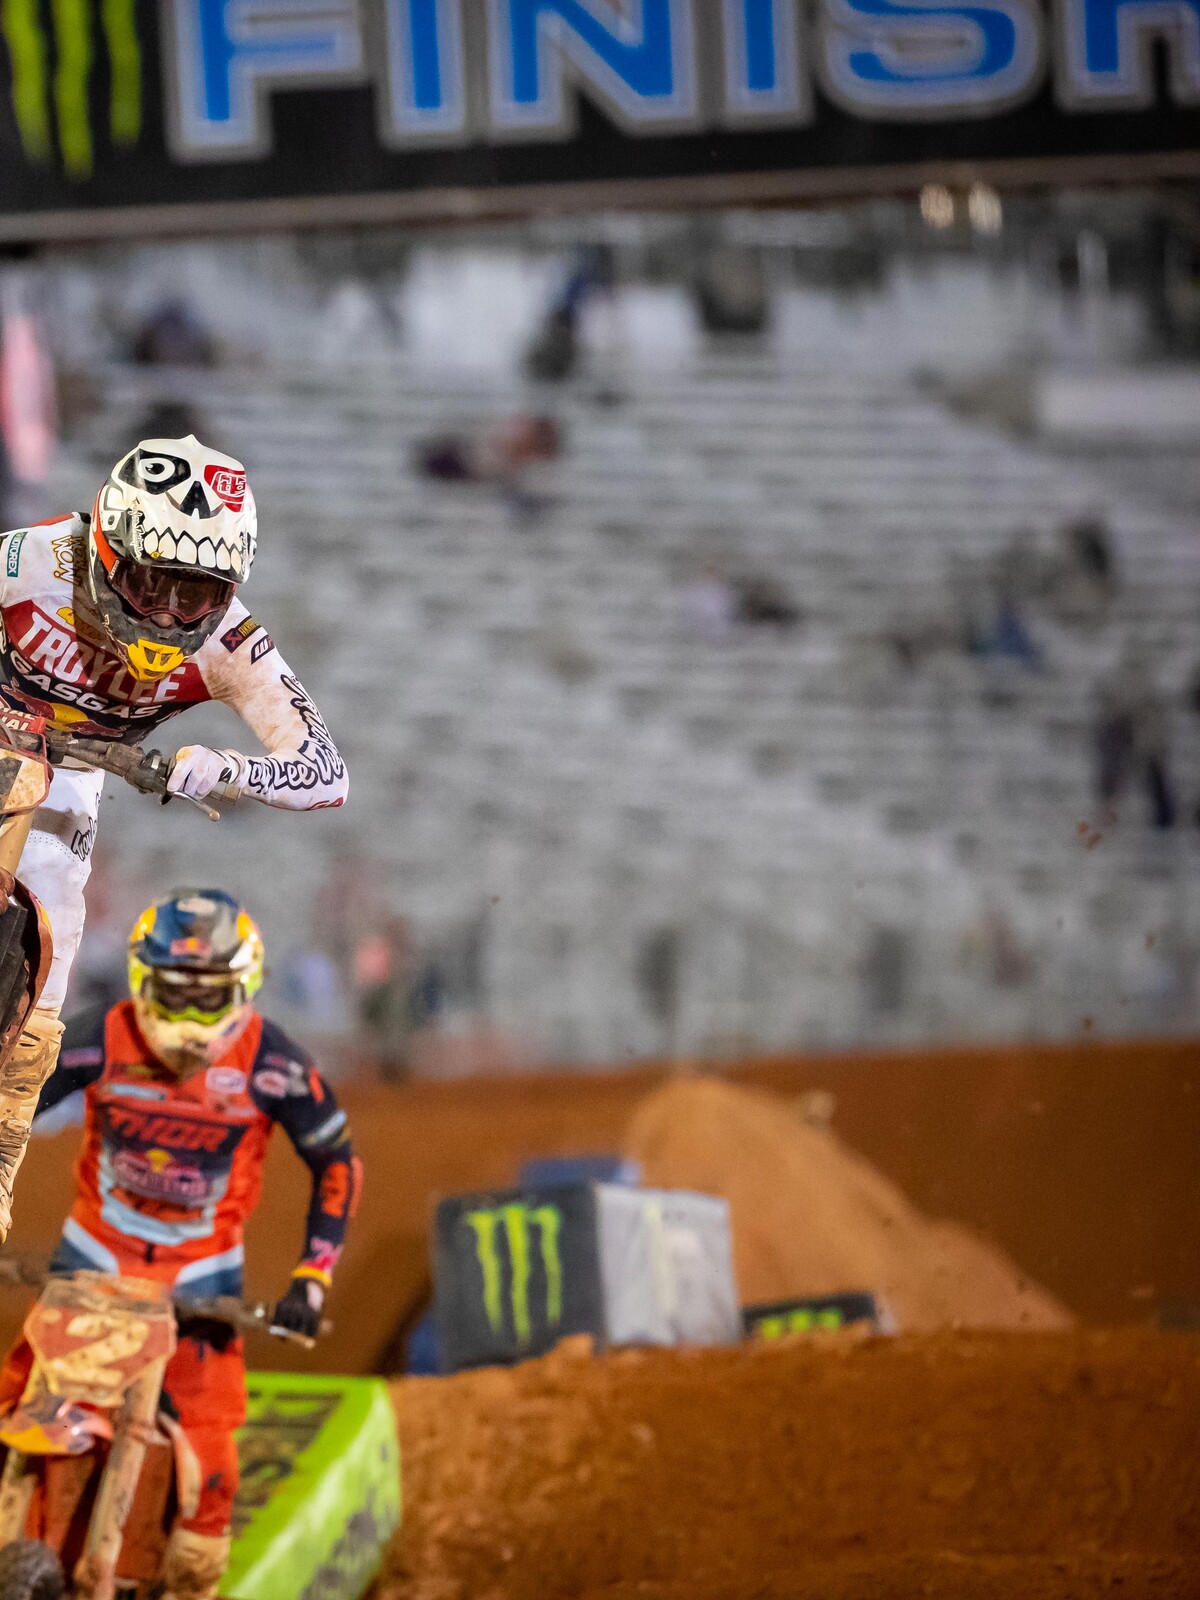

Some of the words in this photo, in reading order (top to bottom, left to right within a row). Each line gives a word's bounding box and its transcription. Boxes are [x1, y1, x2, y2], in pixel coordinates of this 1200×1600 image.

[168, 0, 1200, 165] FINIS
[10, 650, 163, 719] GASGAS
[51, 1311, 149, 1387] 2
